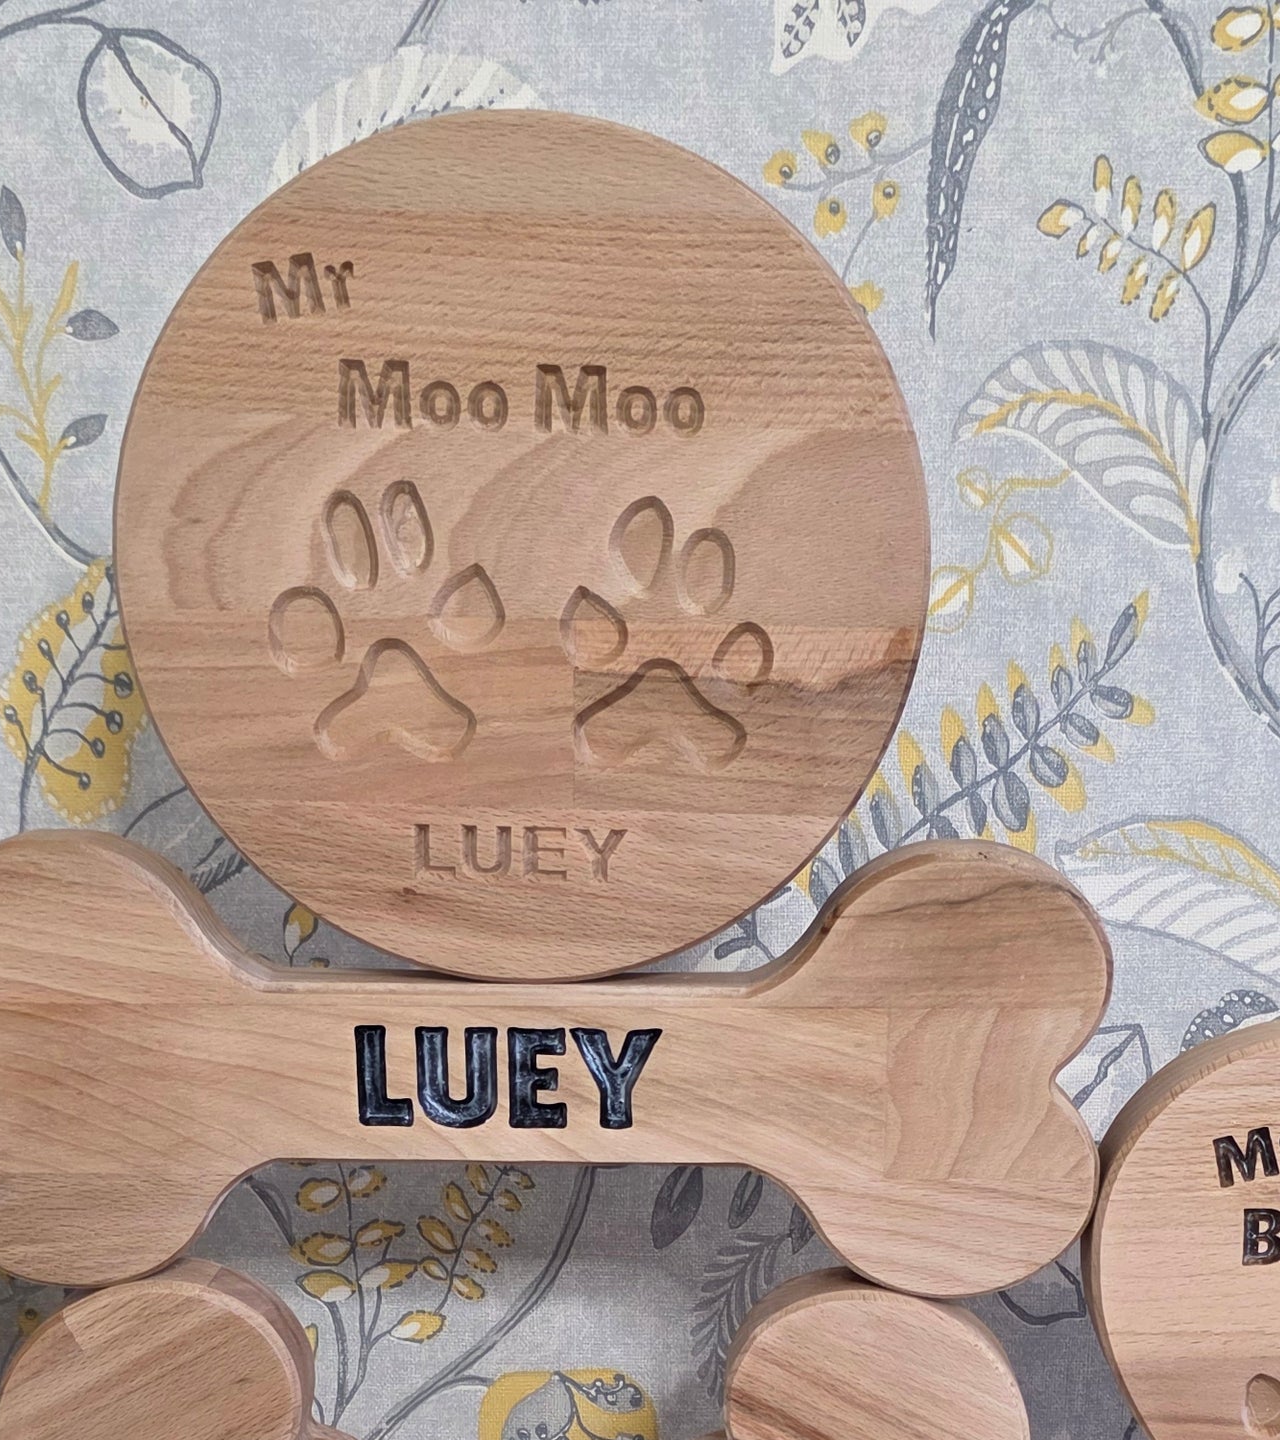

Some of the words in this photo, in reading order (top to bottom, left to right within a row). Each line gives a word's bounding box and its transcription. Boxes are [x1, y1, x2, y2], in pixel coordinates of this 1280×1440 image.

[251, 253, 354, 324] Mr
[338, 359, 509, 433] Moo
[534, 364, 705, 437] Moo
[414, 824, 628, 882] LUEY
[354, 1025, 663, 1129] LUEY
